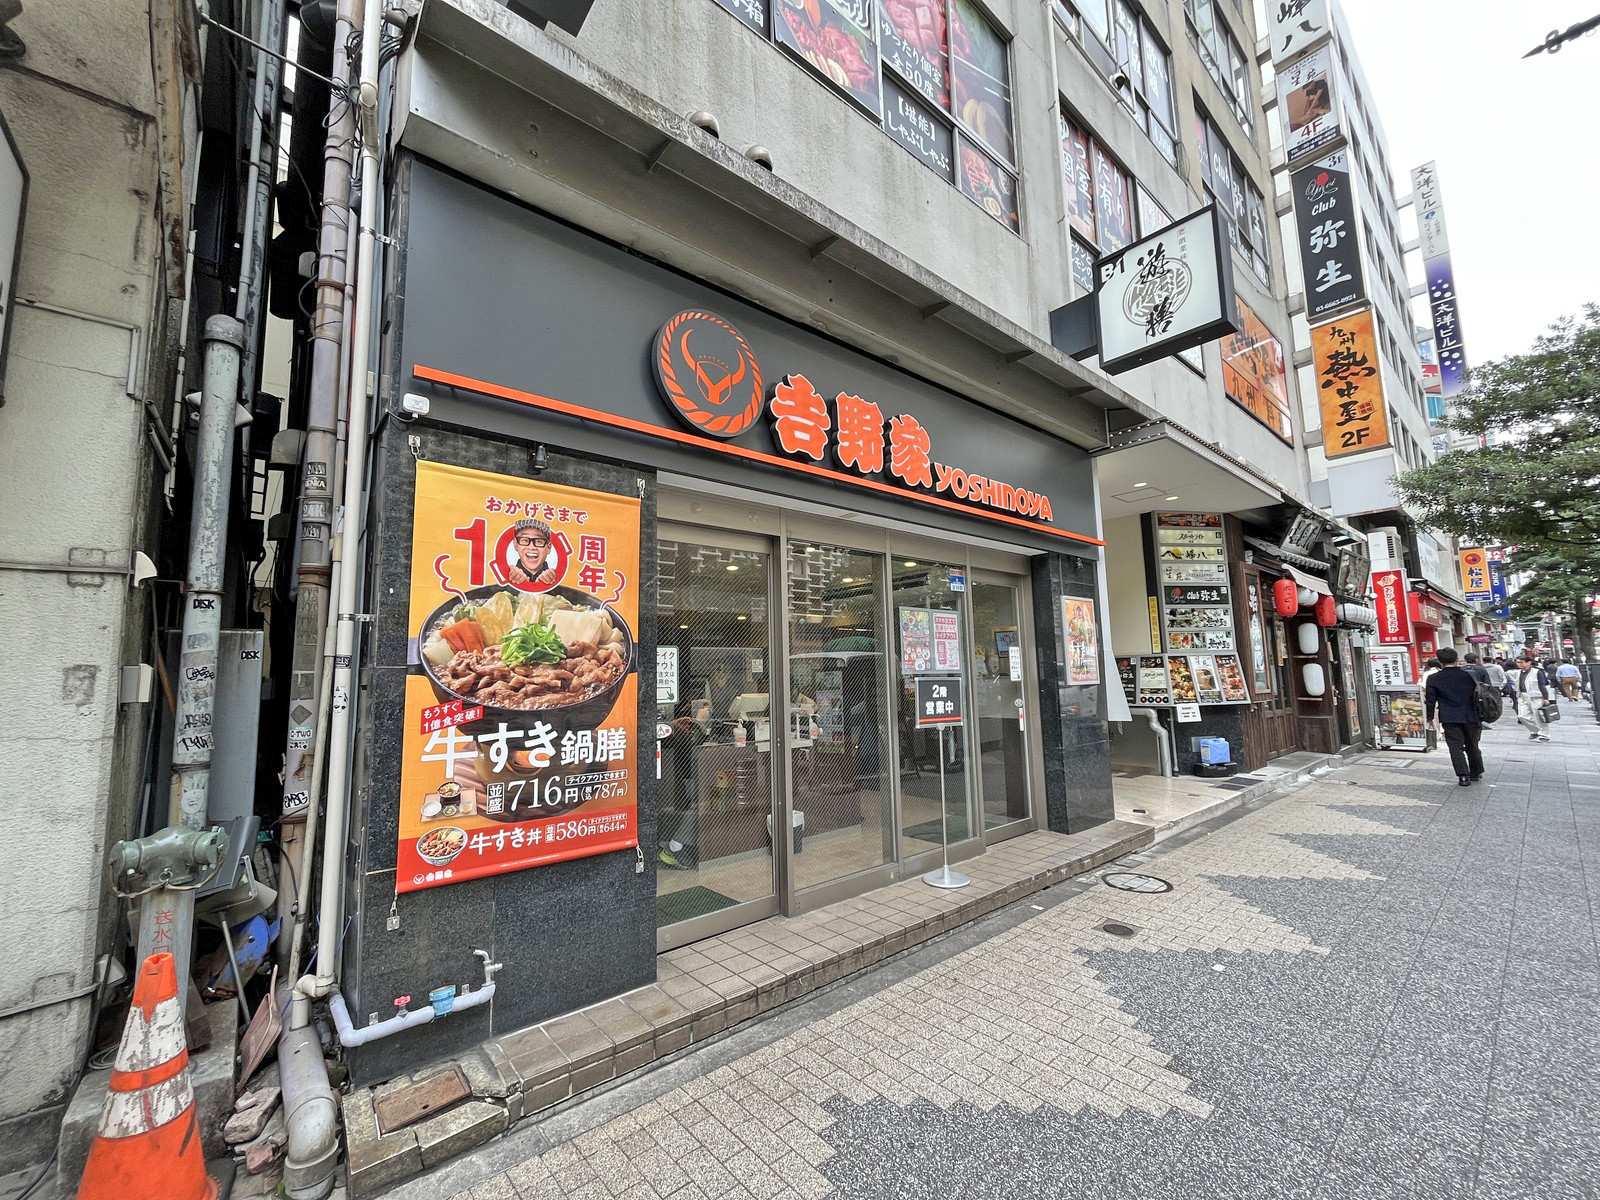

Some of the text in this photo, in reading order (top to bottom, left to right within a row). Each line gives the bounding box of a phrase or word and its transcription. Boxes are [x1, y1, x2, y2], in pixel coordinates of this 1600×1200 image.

[881, 20, 942, 88] ゆったり個室
[891, 51, 934, 98] 全50席
[1301, 117, 1324, 137] 4F
[887, 109, 950, 172] しゃぶしゃぶ
[1213, 151, 1230, 189] Club
[1328, 153, 1345, 168] 3F
[1309, 219, 1353, 294] 弥生
[1100, 255, 1126, 283] B1
[1329, 326, 1357, 347] 九州
[769, 373, 933, 489] 吉野家
[1340, 426, 1370, 448] 2F
[934, 462, 1054, 522] YOSHINOYA
[485, 496, 589, 525] おかげさまで
[578, 534, 607, 594] 周年
[1467, 567, 1484, 588] 松屋
[193, 598, 215, 610] DISK
[1186, 589, 1221, 601] Club 弥生
[241, 650, 260, 660] DISK
[1391, 659, 1400, 678] 港区立
[931, 684, 948, 699] 2階
[423, 702, 461, 719] もうすぐ
[925, 700, 955, 716] 営業中
[420, 720, 627, 779] 牛すき鍋膳
[568, 771, 626, 784] テイクアウトできます
[488, 785, 503, 812] 並盛
[470, 827, 543, 855] 牛すき丼
